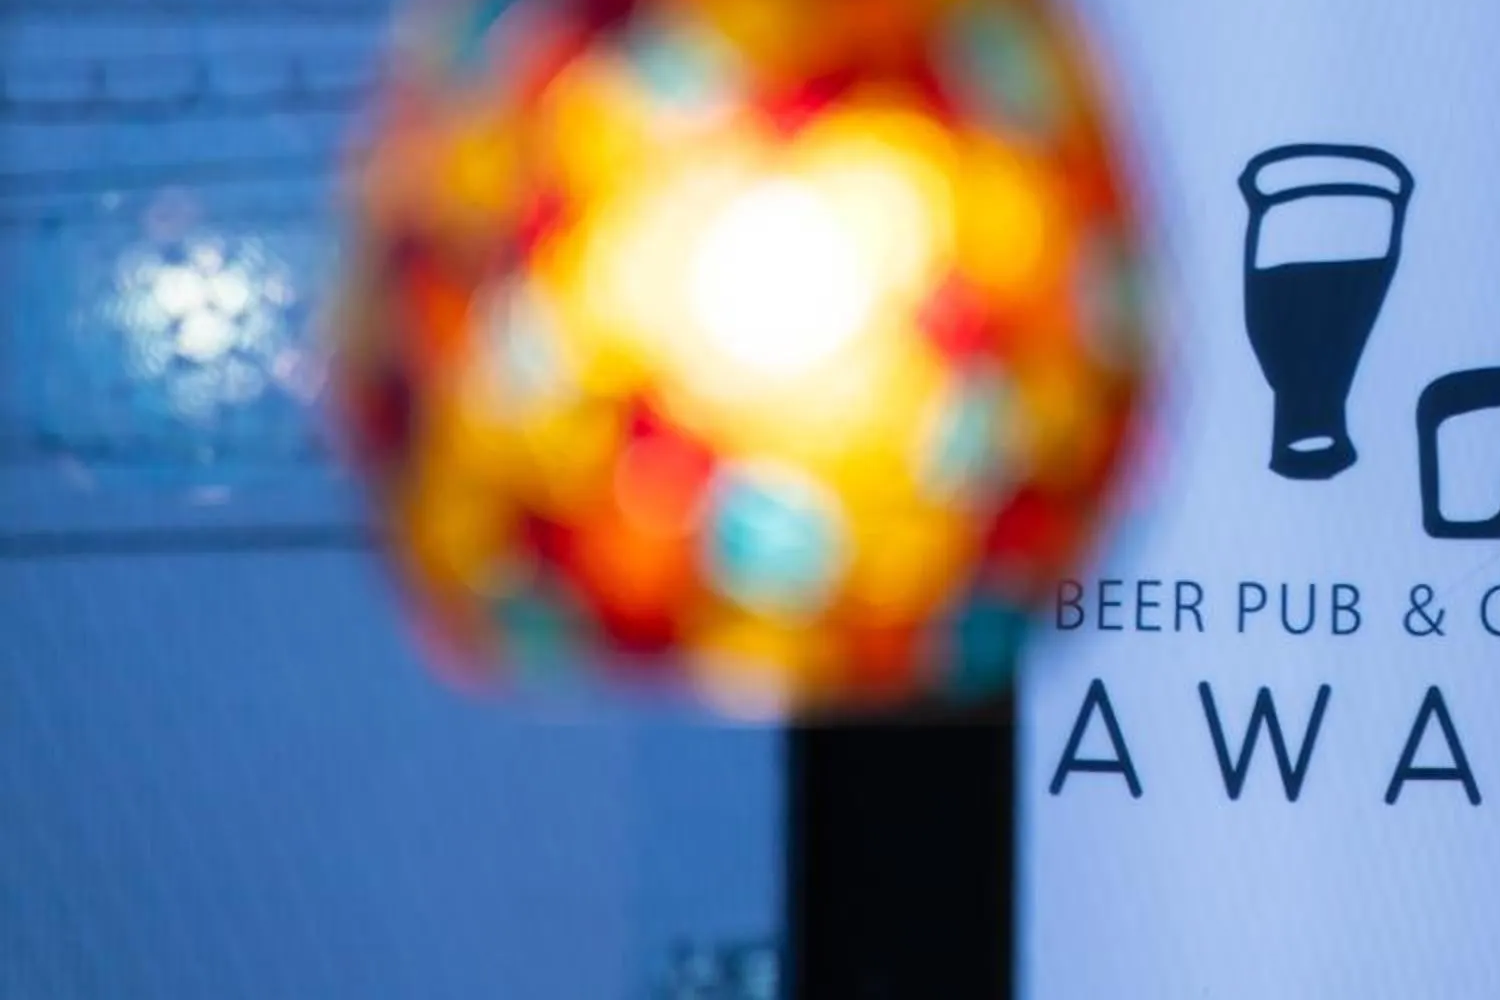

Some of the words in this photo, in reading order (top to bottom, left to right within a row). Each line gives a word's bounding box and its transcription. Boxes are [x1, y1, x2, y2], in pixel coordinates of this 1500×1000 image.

[1055, 579, 1205, 632] BEER
[1236, 582, 1362, 635] PUB
[1402, 583, 1445, 637] &
